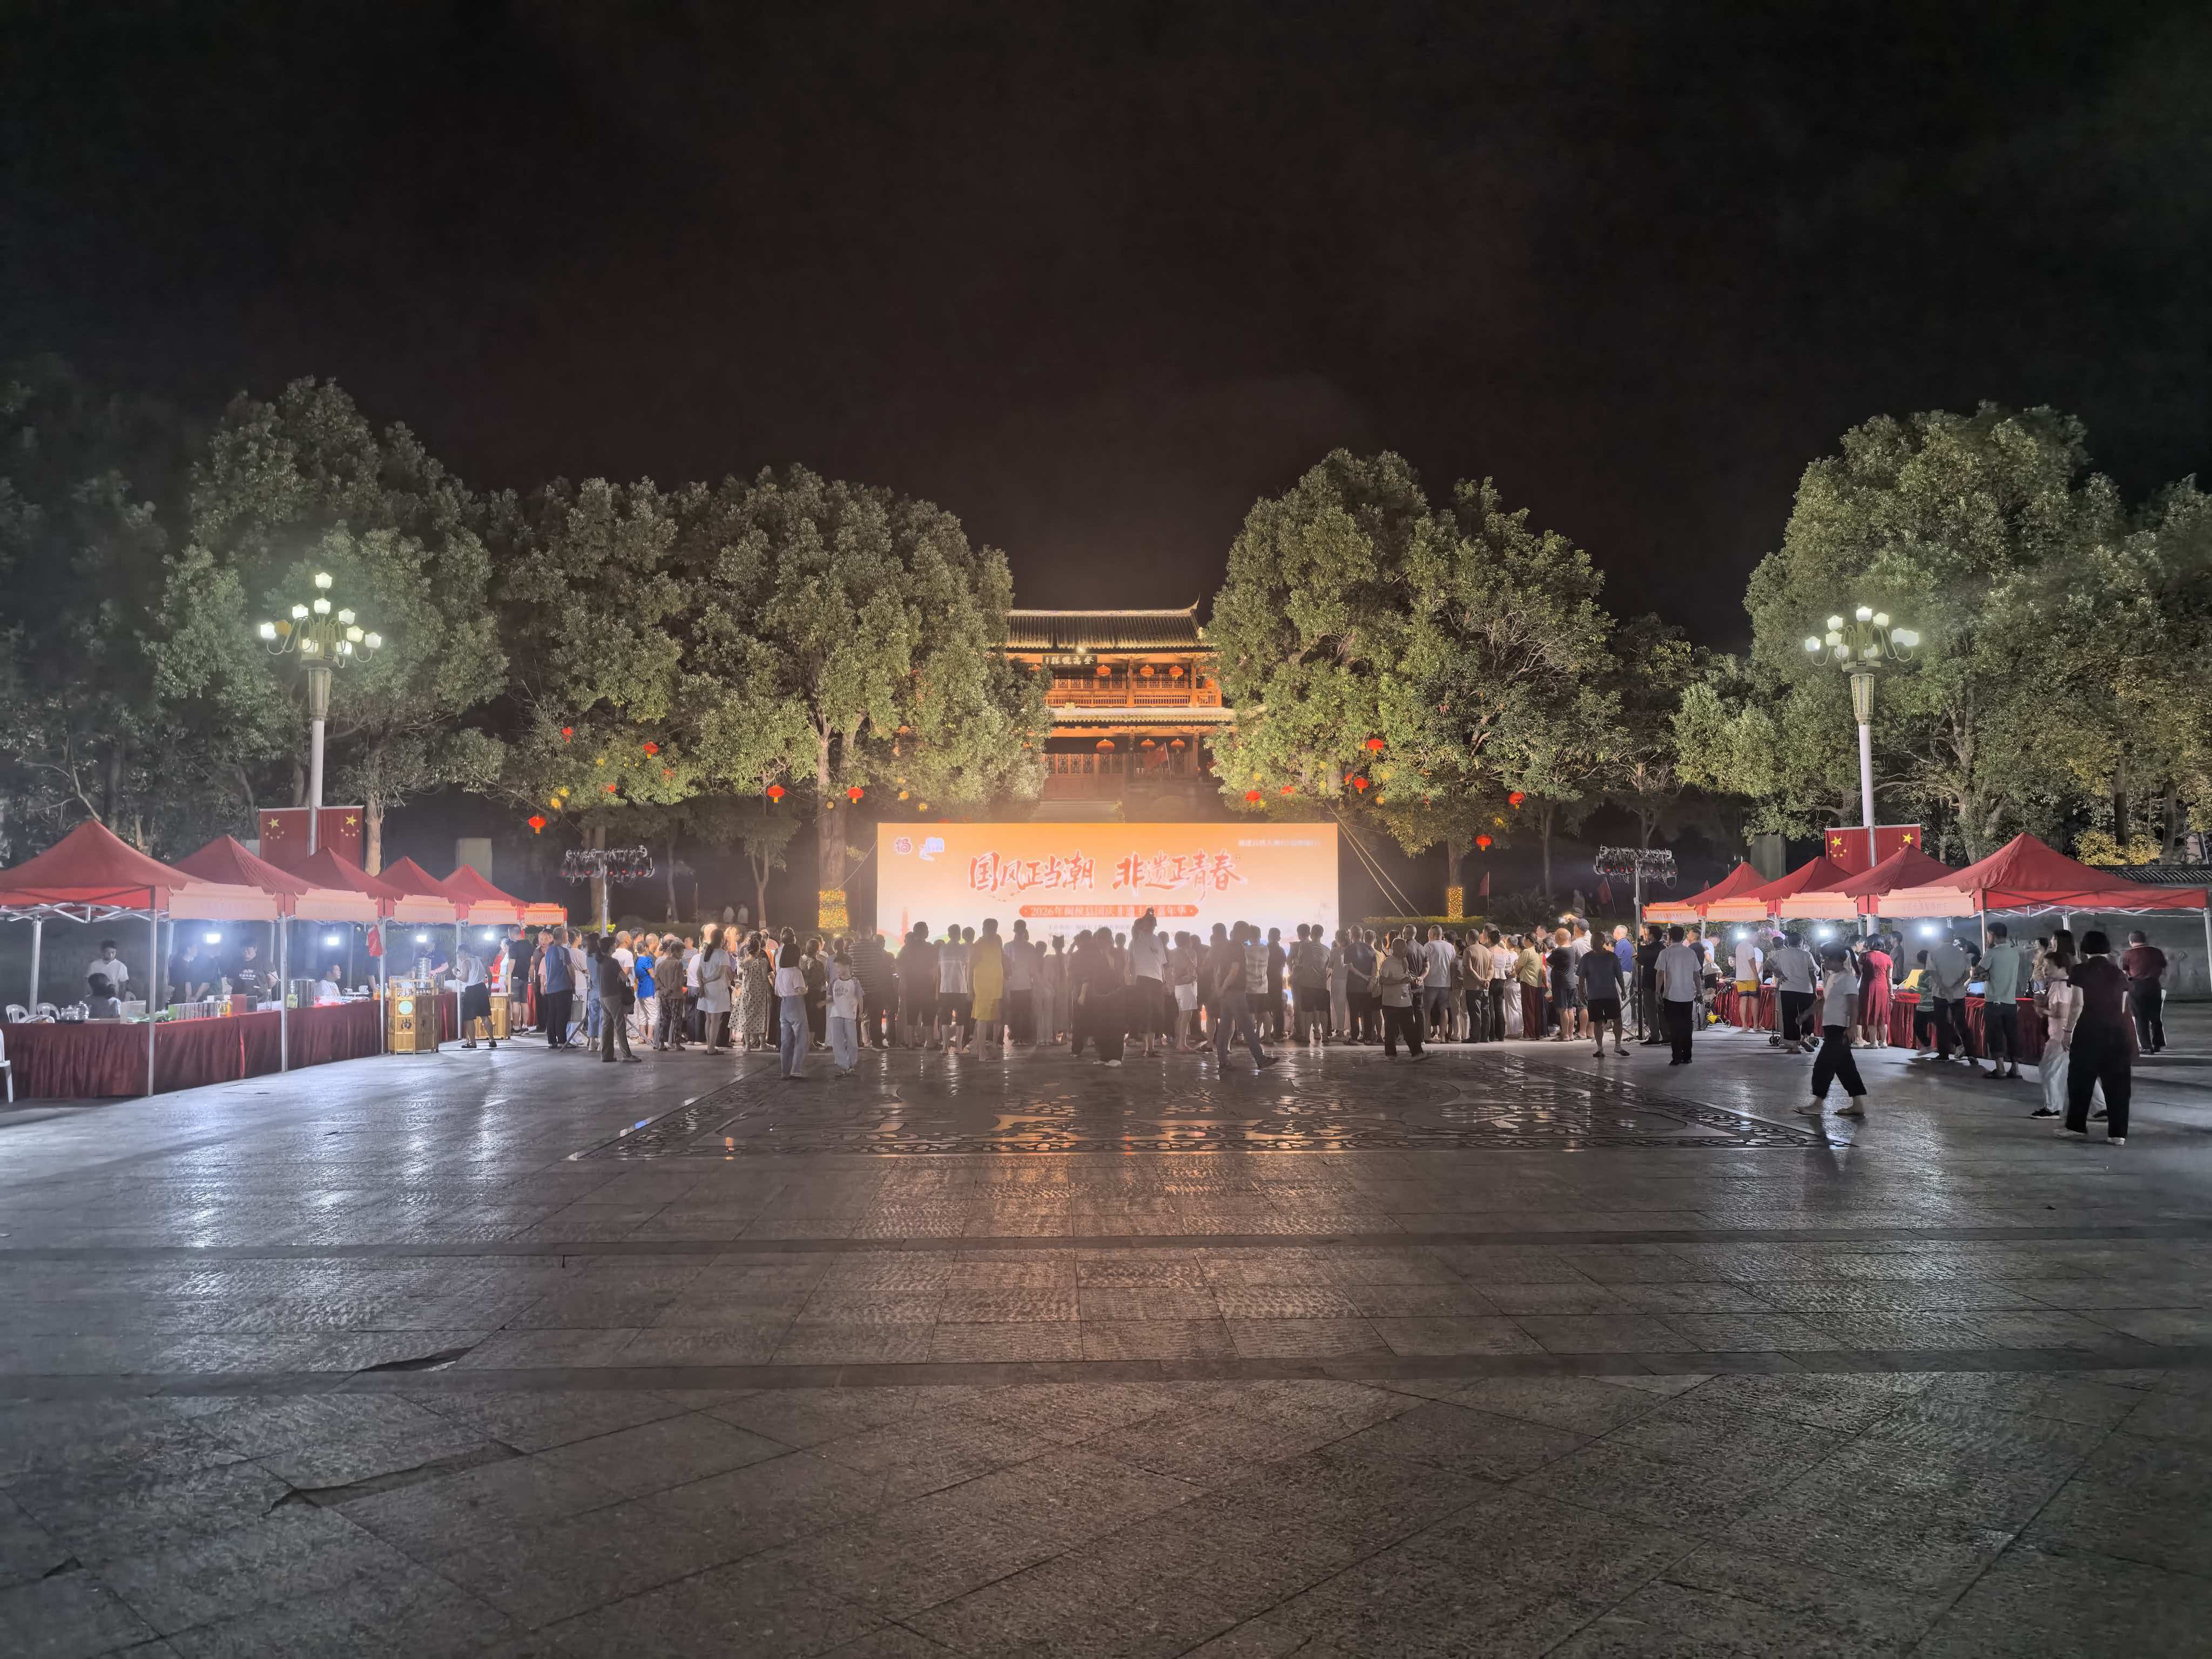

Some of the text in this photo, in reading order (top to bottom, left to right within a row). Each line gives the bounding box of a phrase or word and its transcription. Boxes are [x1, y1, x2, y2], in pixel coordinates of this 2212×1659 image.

[970, 851, 1242, 901] 国风正当潮 非遗正青春
